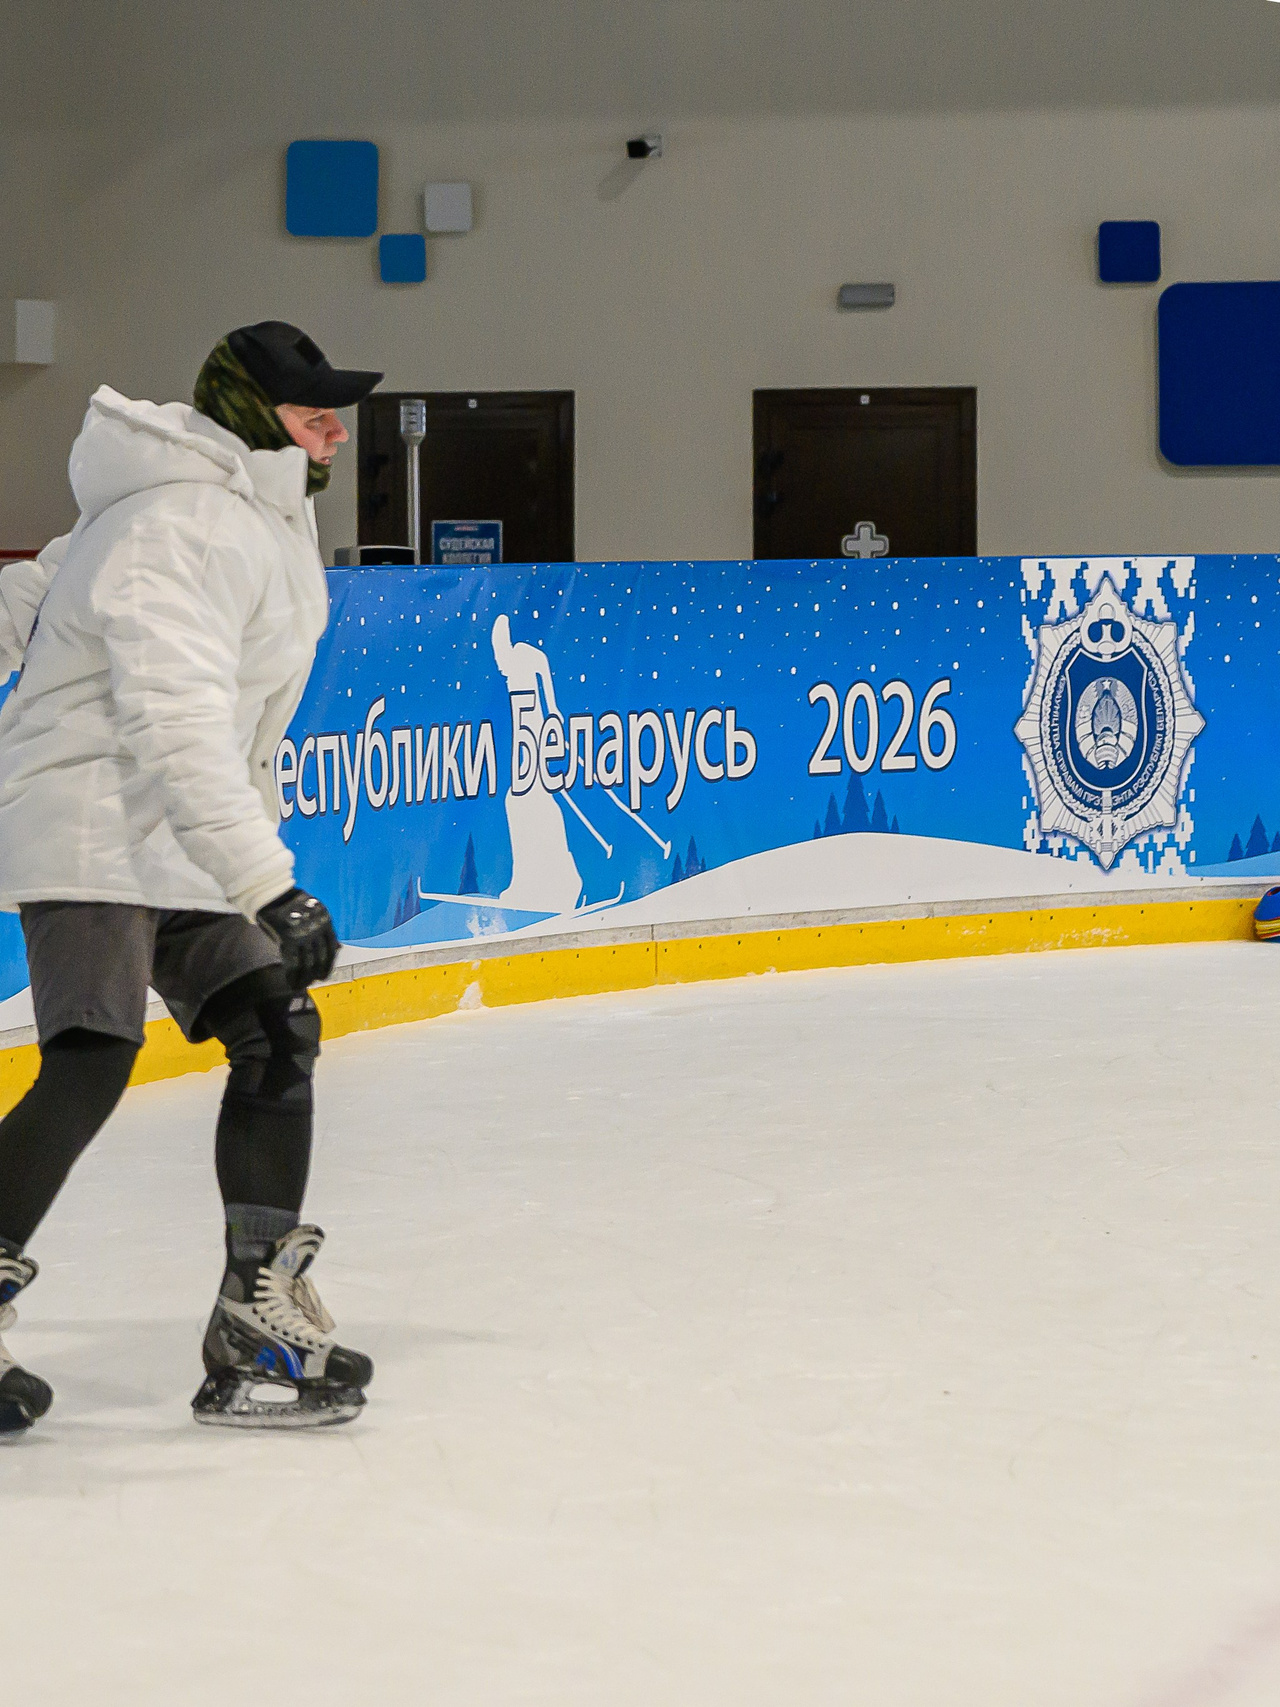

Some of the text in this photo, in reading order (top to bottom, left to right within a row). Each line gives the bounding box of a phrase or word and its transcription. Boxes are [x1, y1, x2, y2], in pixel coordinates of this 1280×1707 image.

[275, 694, 498, 845] еспублики
[510, 690, 758, 812] Беларусь
[808, 677, 958, 776] 2026
